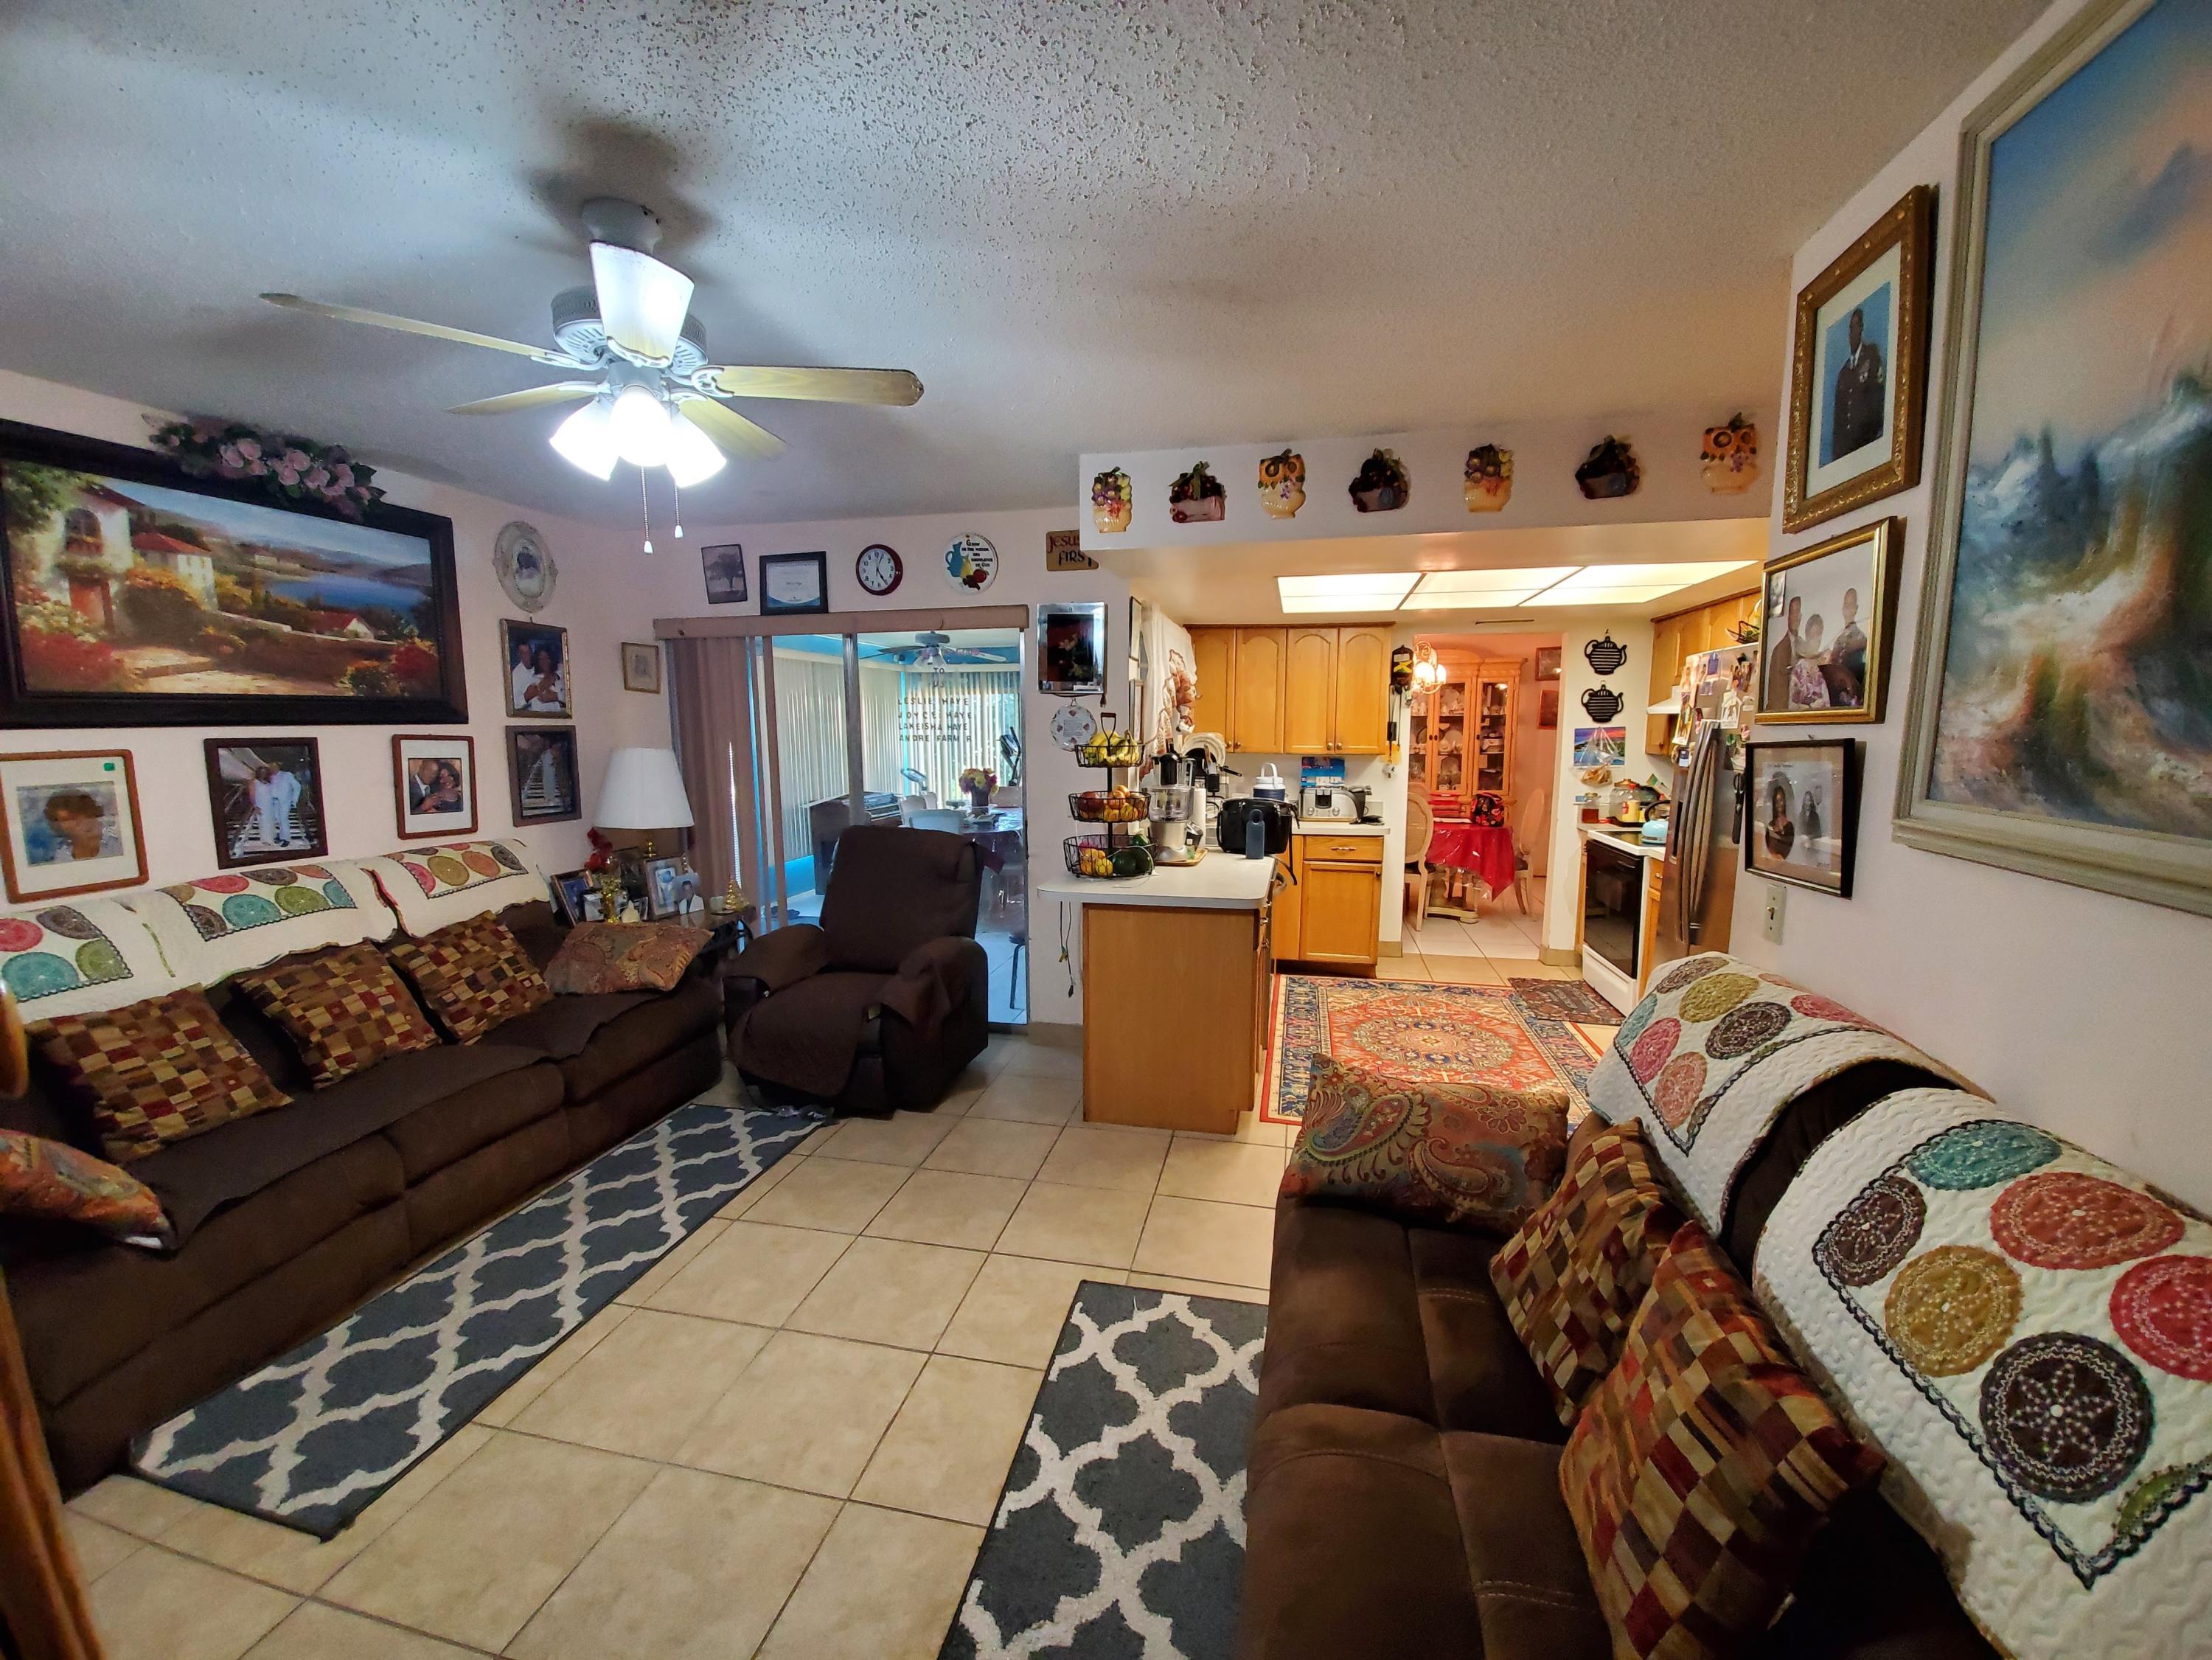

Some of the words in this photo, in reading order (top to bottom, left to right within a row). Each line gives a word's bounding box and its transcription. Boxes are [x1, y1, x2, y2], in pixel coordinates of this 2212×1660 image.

[1047, 535, 1079, 553] JESU
[942, 698, 969, 706] HAYE
[898, 712, 936, 720] JOYCE
[946, 712, 973, 720] HAYE
[899, 723, 943, 731] LAKEISHA
